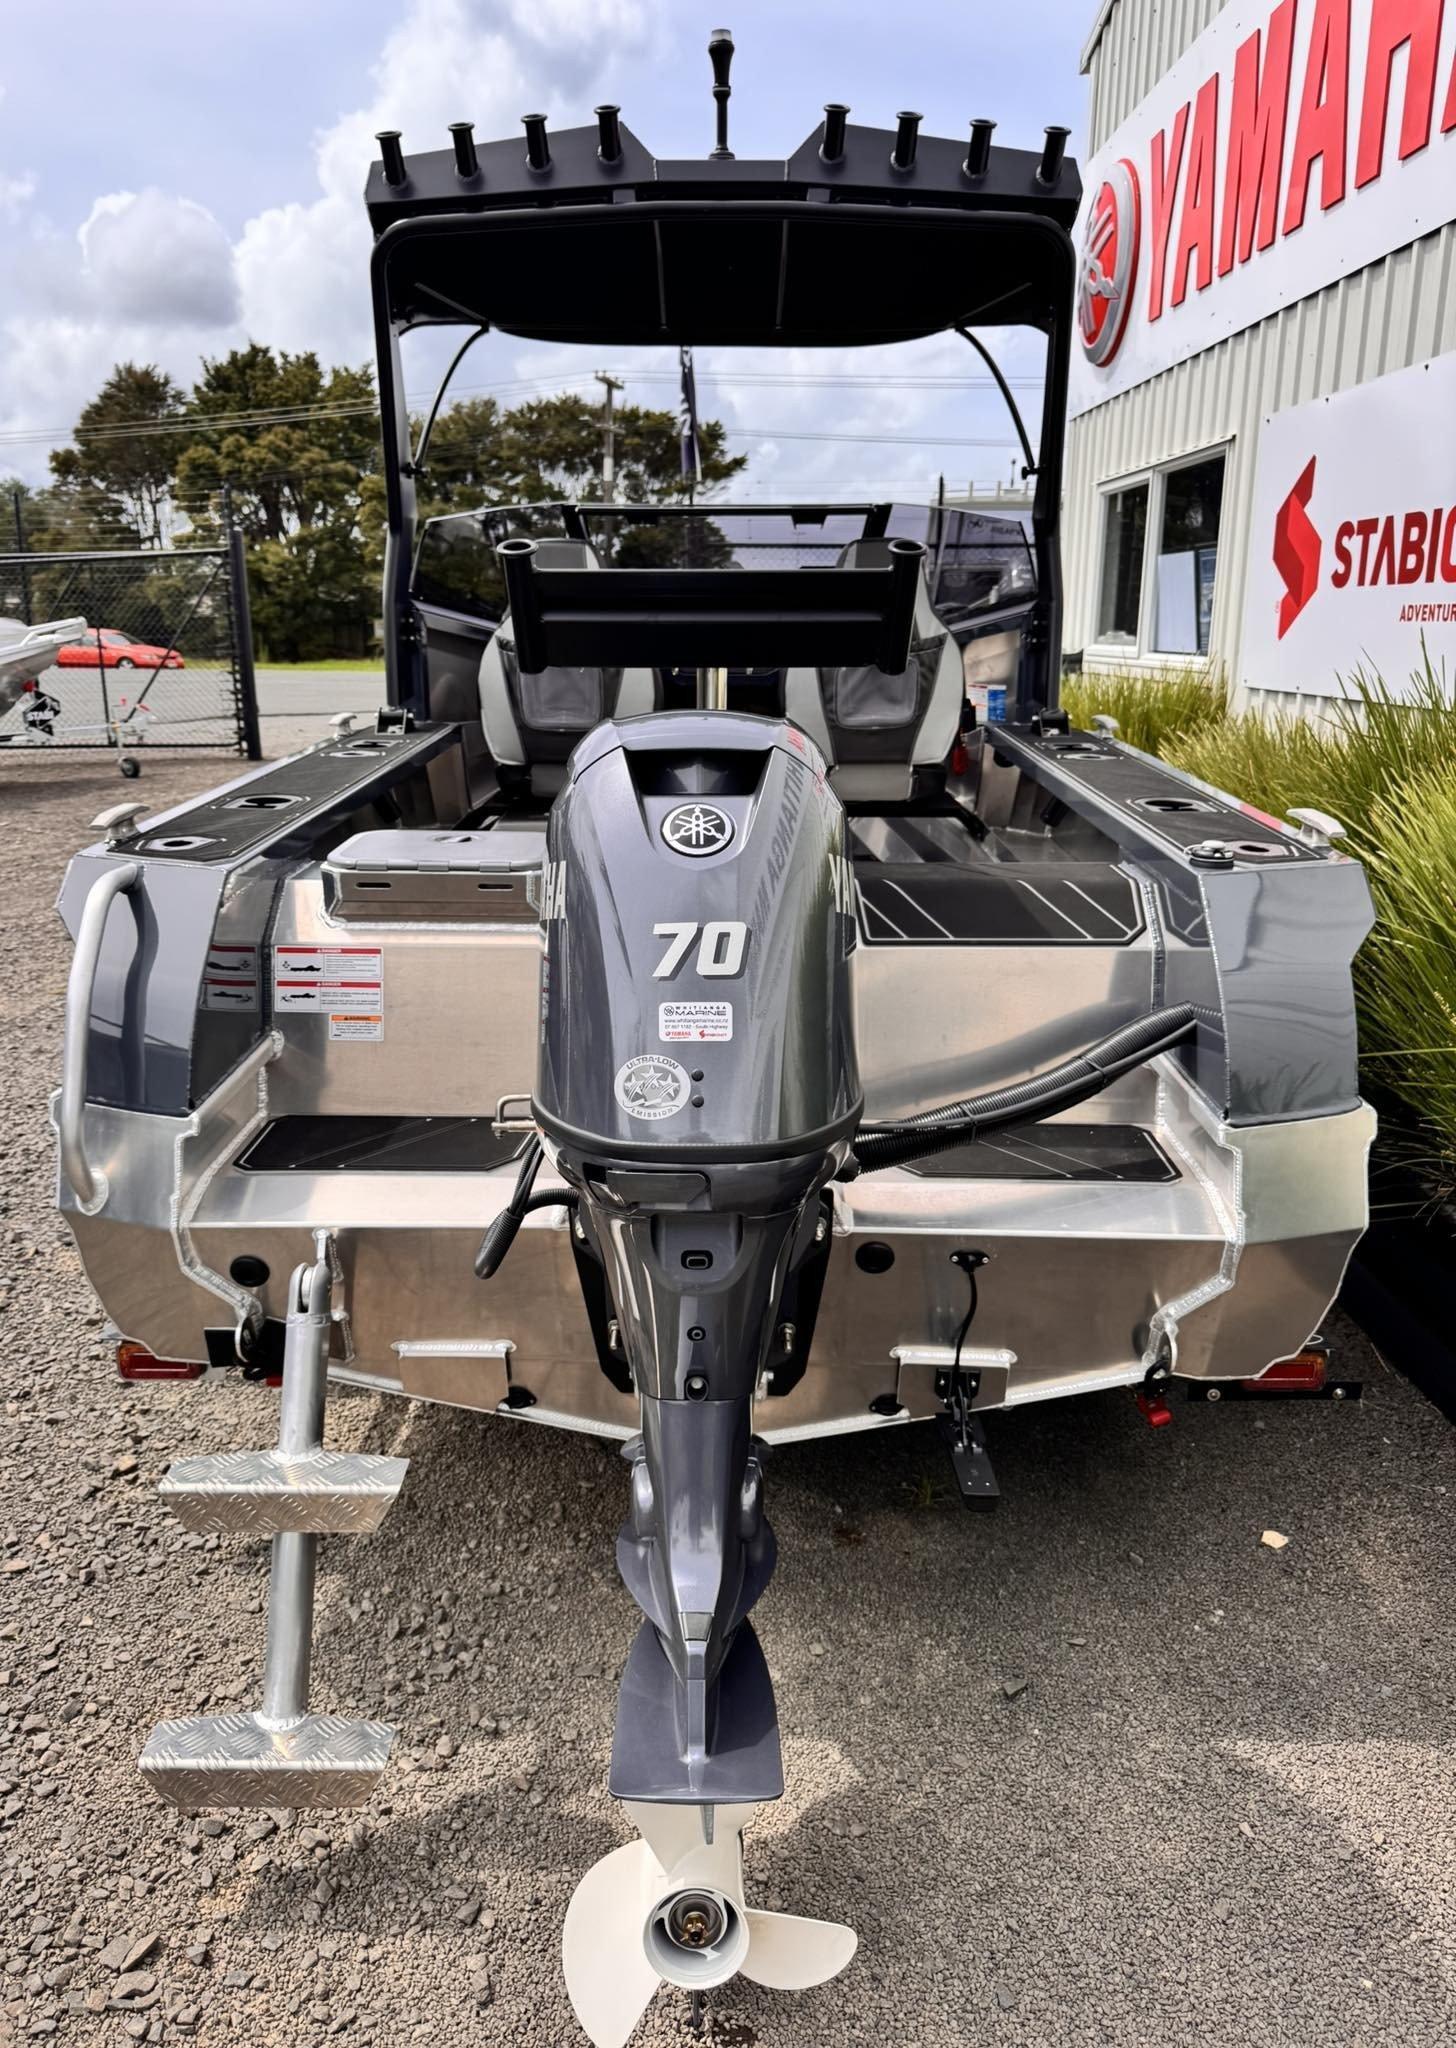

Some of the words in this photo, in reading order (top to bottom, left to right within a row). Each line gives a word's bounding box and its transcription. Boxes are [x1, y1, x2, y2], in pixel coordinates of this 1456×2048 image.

[1148, 0, 1456, 322] YAMAH
[652, 921, 748, 978] 70
[631, 1107, 673, 1118] EMISSION
